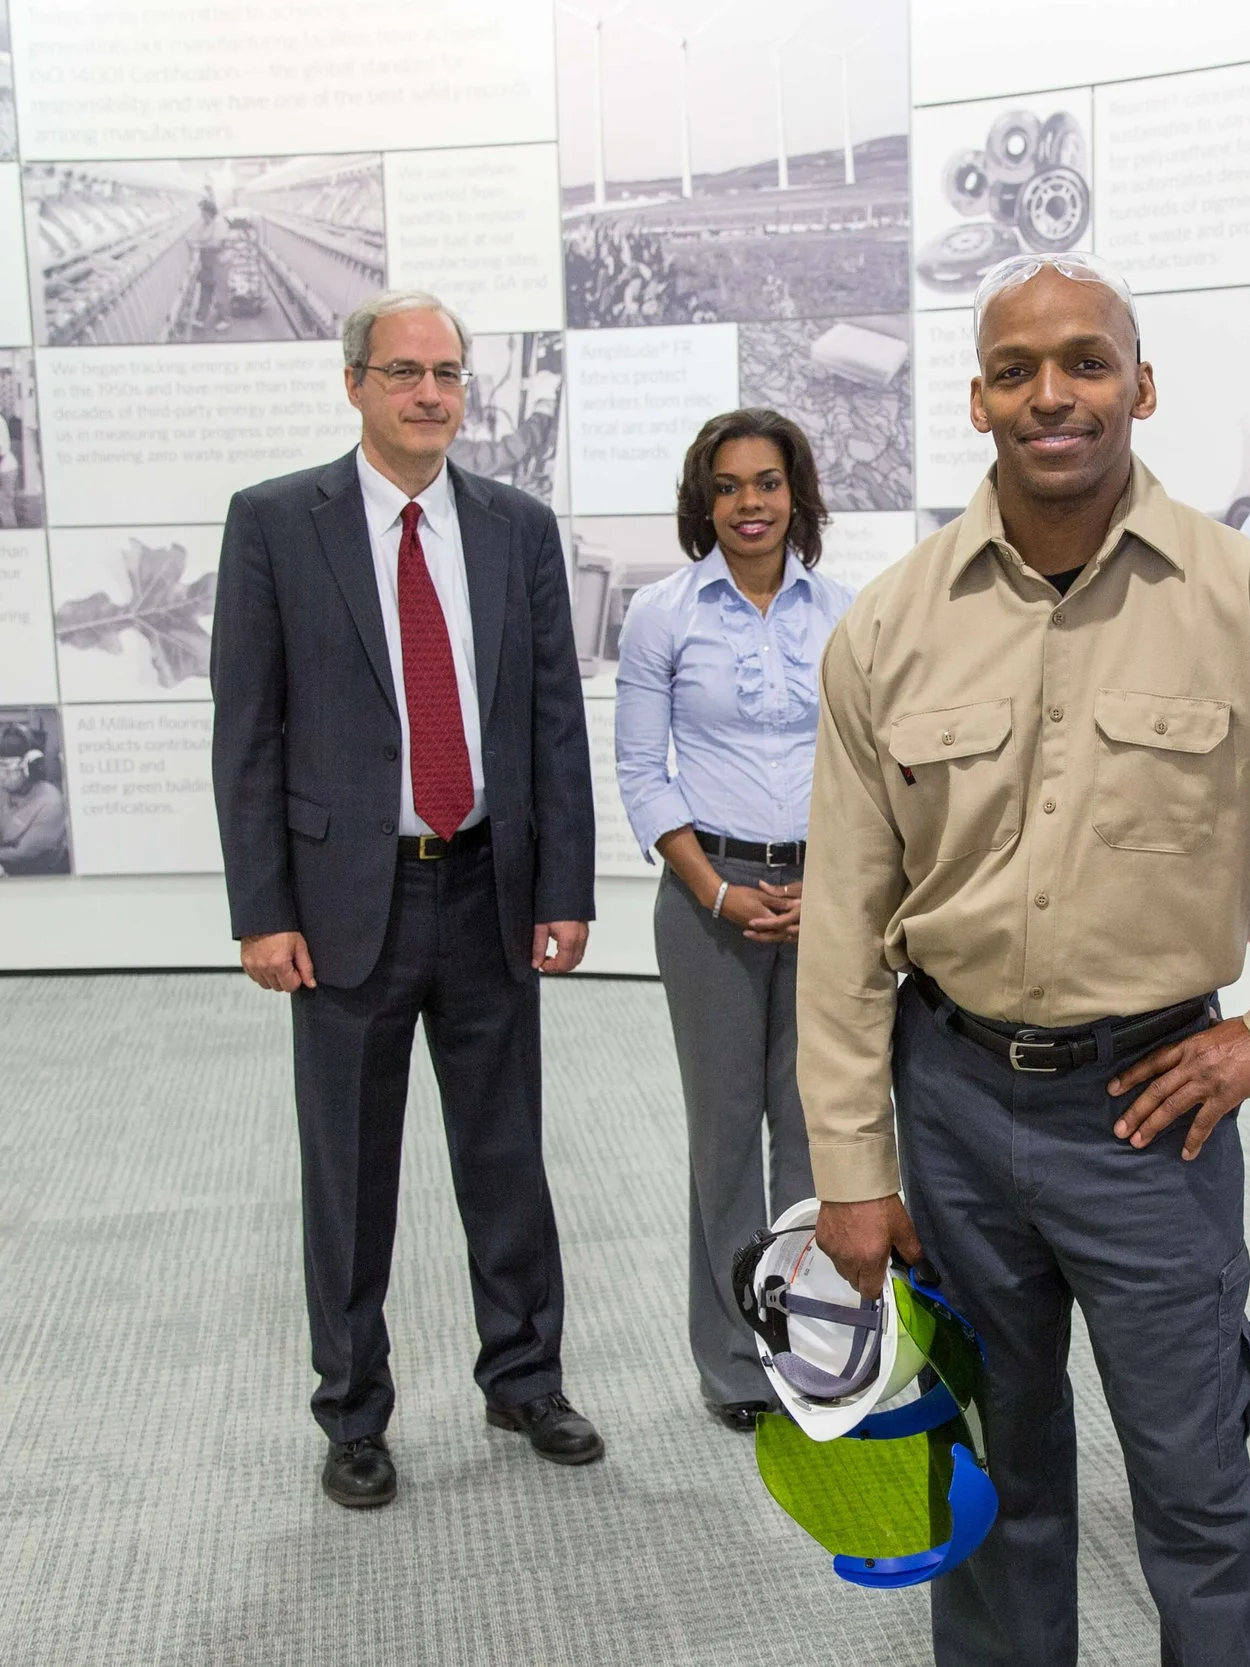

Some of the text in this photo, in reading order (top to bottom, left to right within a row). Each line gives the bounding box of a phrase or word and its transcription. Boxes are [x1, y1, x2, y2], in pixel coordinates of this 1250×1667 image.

[145, 382, 172, 396] and
[80, 757, 166, 775] to LEED and
[81, 778, 213, 798] other green buildin
